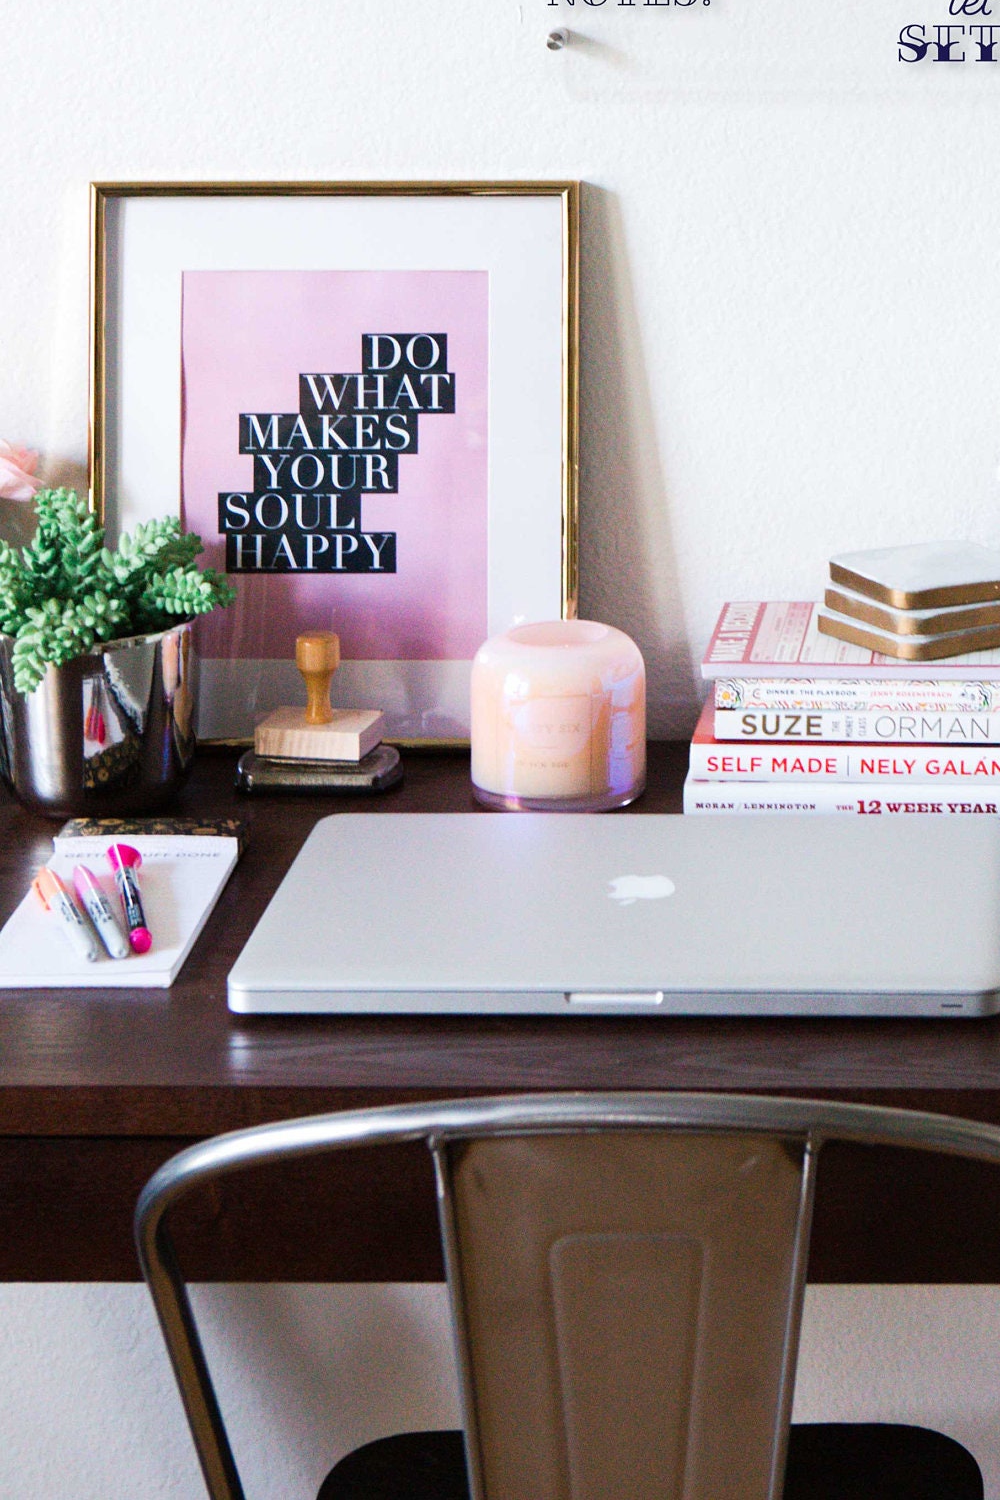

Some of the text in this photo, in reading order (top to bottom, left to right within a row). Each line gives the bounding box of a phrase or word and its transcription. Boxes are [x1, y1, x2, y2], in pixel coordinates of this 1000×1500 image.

[367, 333, 441, 371] DO
[302, 373, 451, 411] WHAT
[244, 413, 411, 451] MAKES
[257, 453, 394, 491] YOUR
[224, 492, 356, 531] SOUL
[231, 533, 393, 570] HAPPY
[816, 689, 858, 697] PLAYBOOK
[741, 714, 823, 737] SUZE
[874, 715, 990, 739] ORMAN
[706, 756, 838, 774] SELF MADE
[859, 759, 917, 775] NELY
[743, 803, 817, 811] LENNINGTON
[856, 800, 882, 815] 12
[886, 802, 944, 815] WEEK
[947, 803, 998, 815] YEAR
